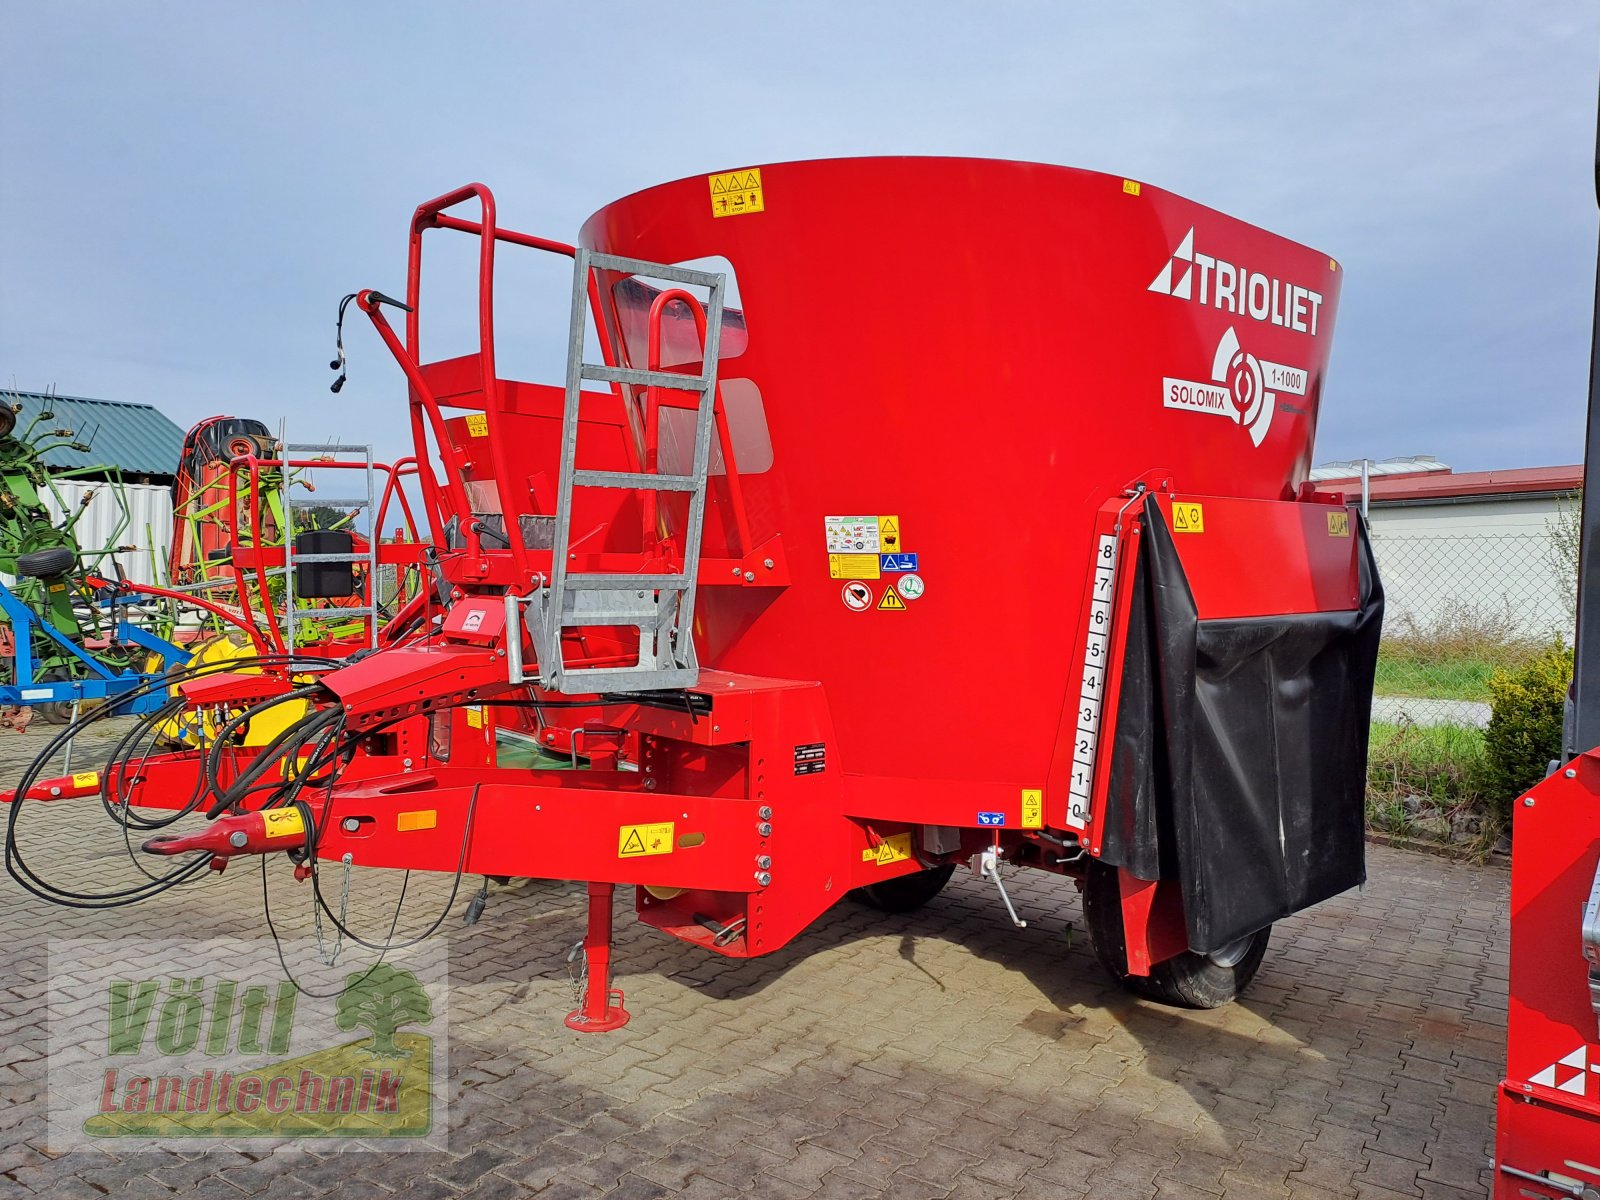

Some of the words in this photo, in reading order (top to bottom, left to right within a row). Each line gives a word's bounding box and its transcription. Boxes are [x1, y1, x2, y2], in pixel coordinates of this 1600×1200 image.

[1195, 252, 1322, 336] TRIOLIET
[1271, 368, 1301, 389] 1-1000
[1170, 384, 1225, 410] SOLOMIX
[1103, 545, 1112, 558] 8
[1100, 578, 1109, 591] 7
[1095, 611, 1104, 624] 6
[1091, 643, 1100, 657] 5
[1087, 676, 1096, 689] 4
[1083, 708, 1092, 721] 3
[1079, 741, 1088, 754] 2
[1077, 773, 1083, 785] 1
